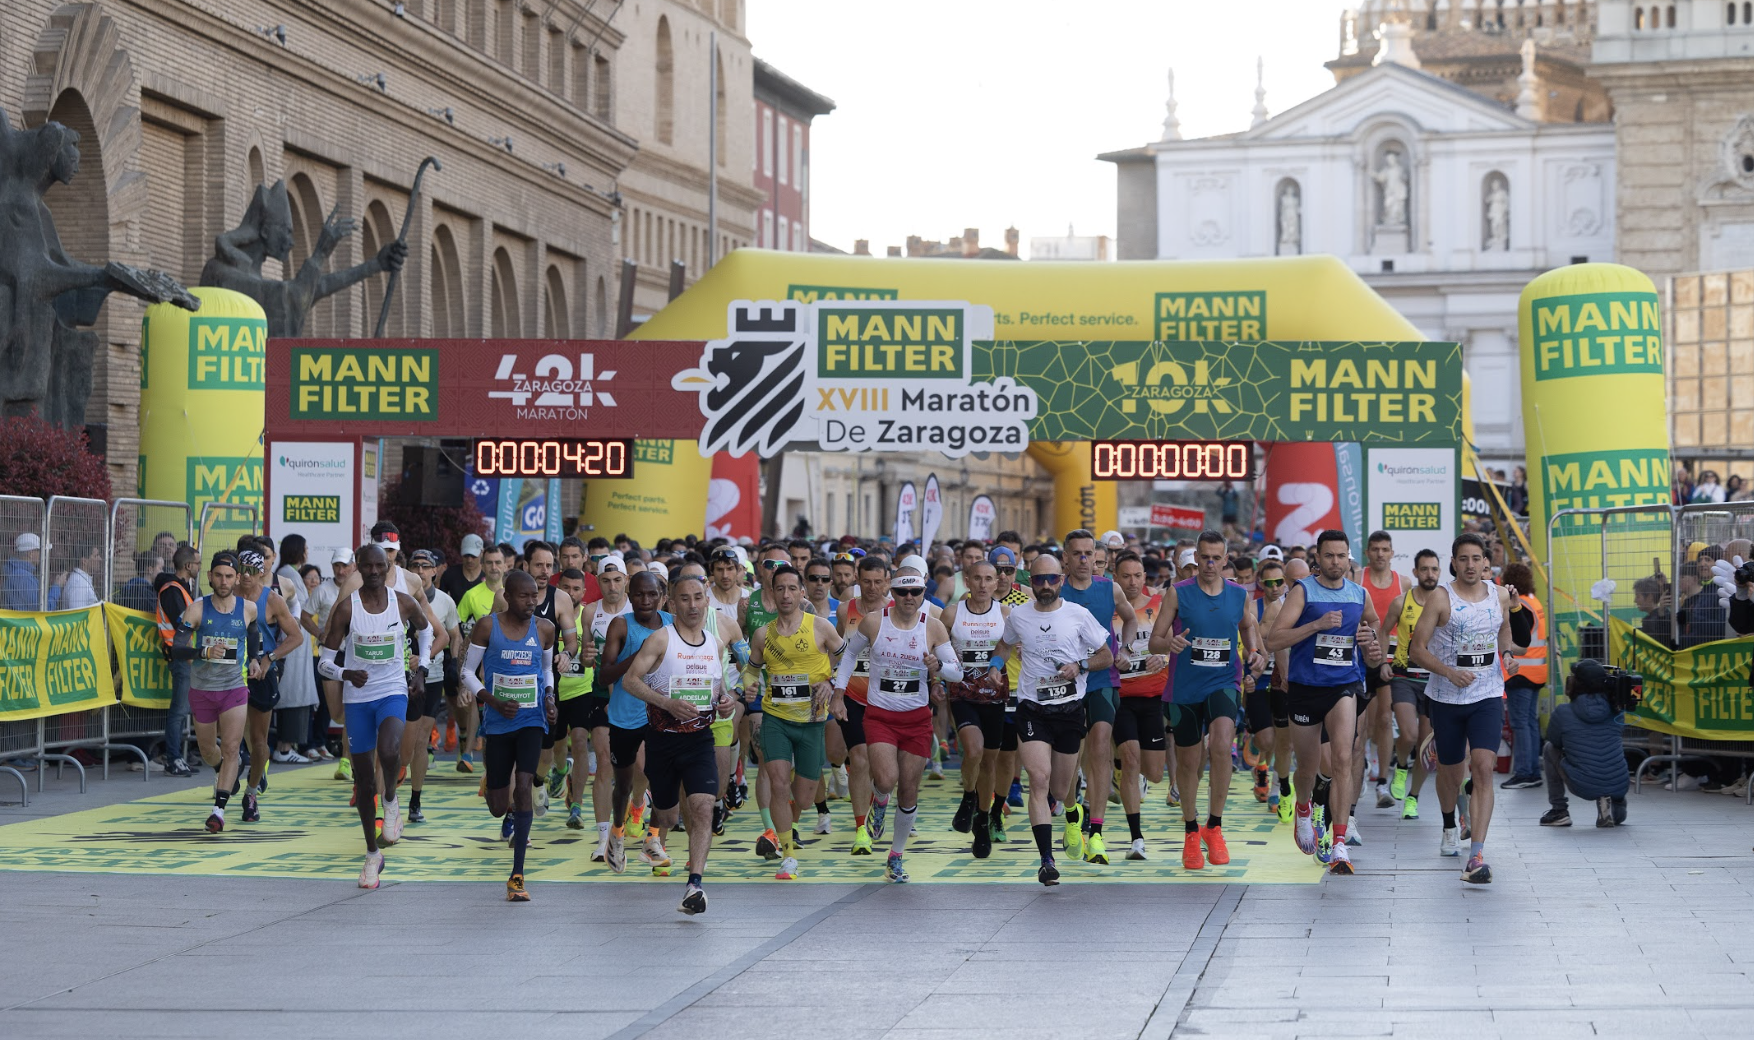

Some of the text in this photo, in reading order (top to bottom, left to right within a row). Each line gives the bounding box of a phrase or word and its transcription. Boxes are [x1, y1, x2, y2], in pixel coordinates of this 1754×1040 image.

[1160, 296, 1260, 318] MANN
[1020, 312, 1076, 326] Perfect
[1079, 312, 1139, 326] service.
[1538, 301, 1659, 336] MANN
[827, 315, 955, 341] MANN
[1160, 320, 1261, 341] FILTER
[827, 345, 955, 371] FILTER
[1540, 336, 1661, 371] FILTER
[300, 354, 431, 383] MANN
[1291, 359, 1437, 389] MANN
[513, 381, 593, 393] ZARAGOZA
[1131, 386, 1215, 398] ZARAGOZA
[299, 386, 431, 413] FILTER
[816, 385, 1030, 412] XVIII Maratón
[517, 405, 588, 420] MARATÓN
[1291, 393, 1437, 423] FILTER
[827, 420, 1021, 449] De Zaragoza
[289, 459, 346, 470] quirónsalud
[1387, 465, 1447, 477] quirónsalud
[1548, 458, 1669, 494] MANN
[286, 497, 337, 508] MANN
[612, 491, 667, 505] Perfect parts.
[286, 509, 337, 520] FILTER
[607, 501, 670, 515] Perfect service.
[1385, 505, 1438, 516] MANN
[1385, 517, 1438, 528] FILTER
[51, 619, 89, 656] MANN
[900, 653, 920, 661] ZUERA
[974, 652, 988, 660] 26
[1203, 650, 1221, 659] 128
[1328, 648, 1344, 657] 43
[1471, 655, 1485, 664] 111
[49, 657, 96, 695] FILTER
[781, 687, 797, 695] 161
[893, 681, 908, 689] 27
[1048, 686, 1067, 696] 130
[499, 691, 531, 699] CHERUIYOT
[1294, 713, 1310, 722] RUBÉN
